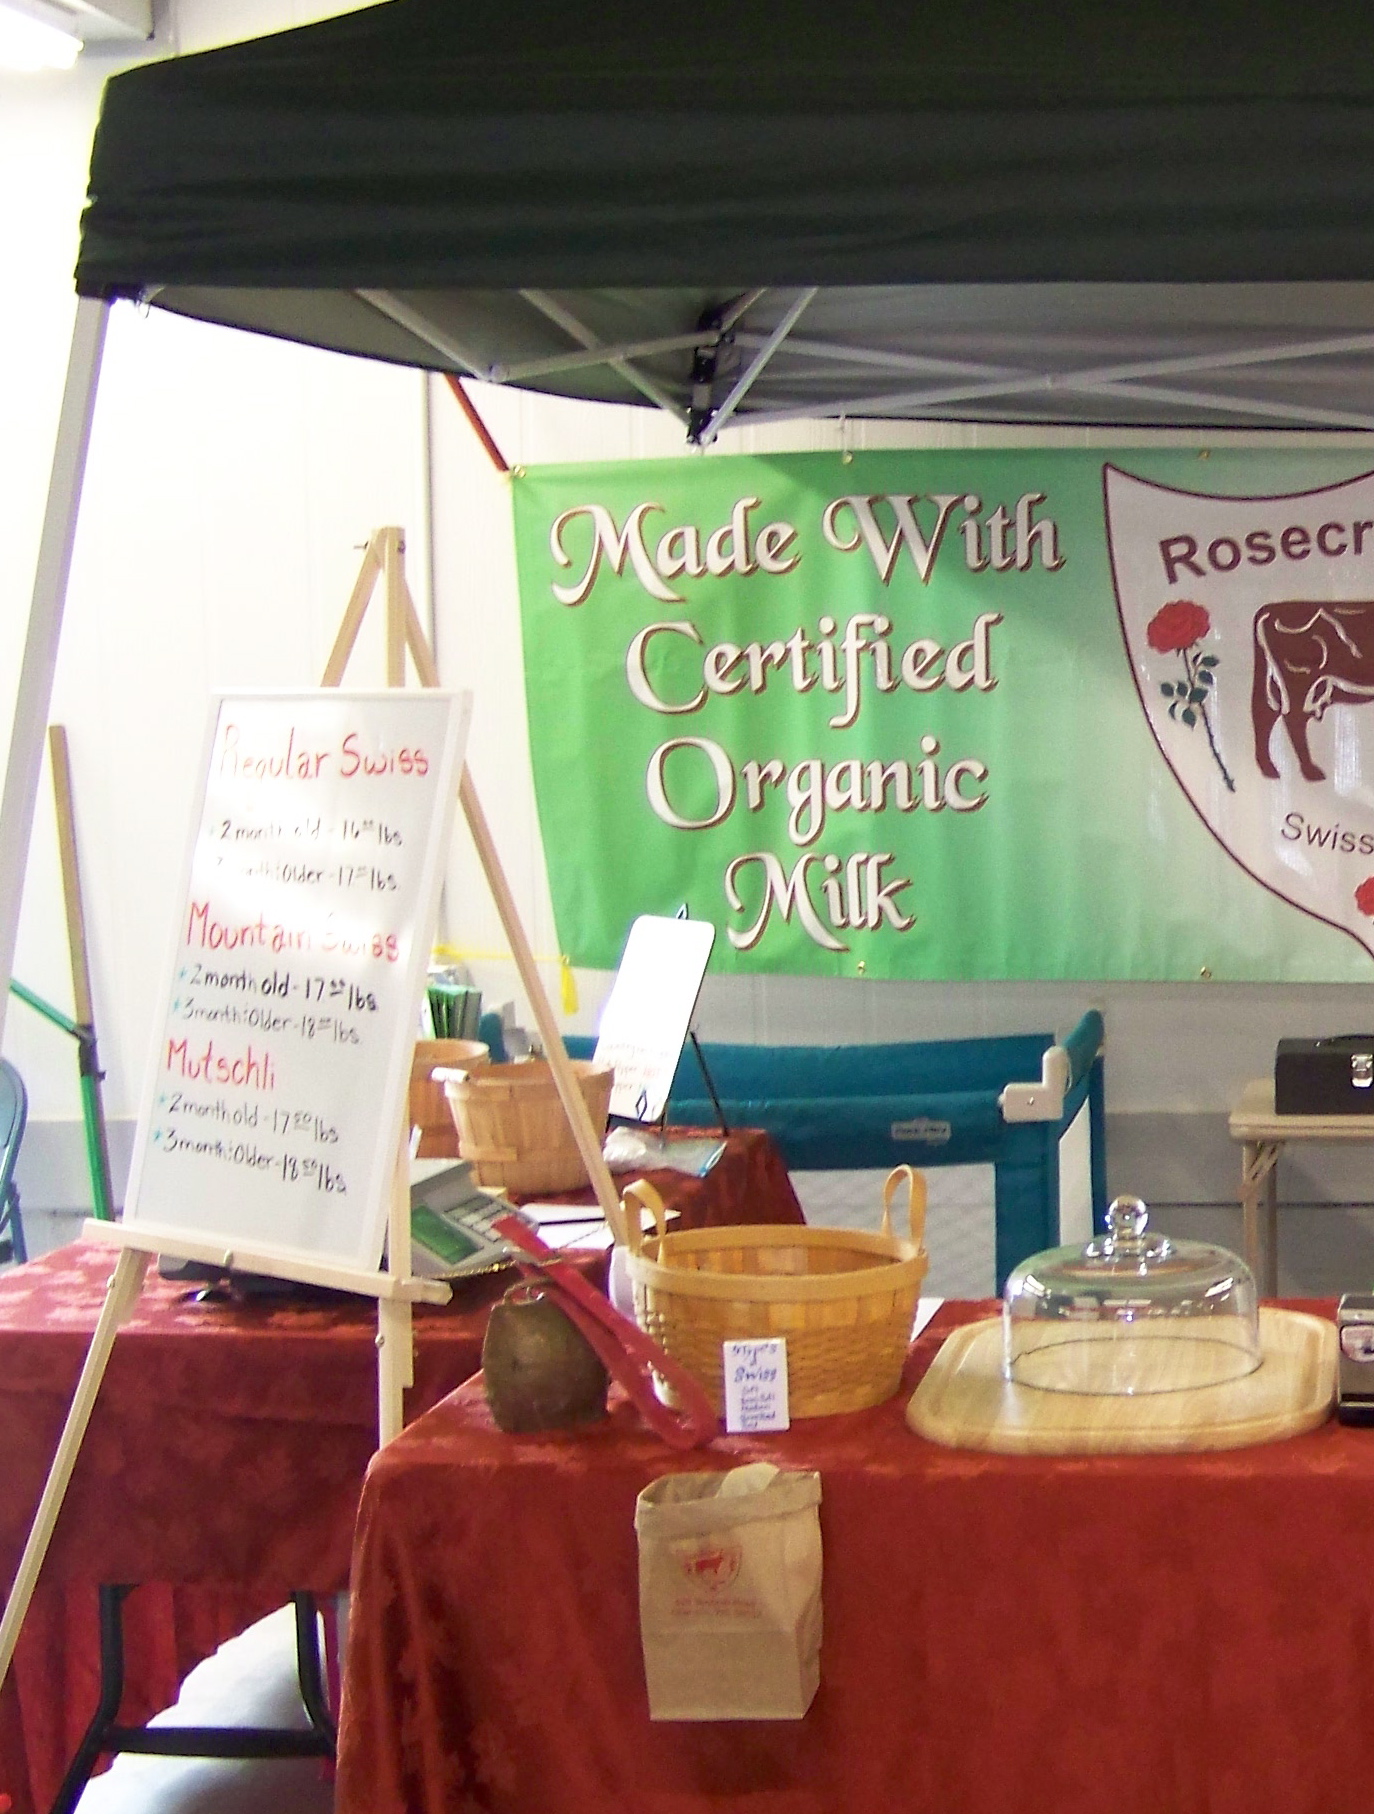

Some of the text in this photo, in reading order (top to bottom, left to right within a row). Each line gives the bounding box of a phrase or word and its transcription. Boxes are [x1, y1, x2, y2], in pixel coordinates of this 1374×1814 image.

[550, 492, 1067, 606] Made With
[625, 612, 1004, 728] Certified
[340, 733, 429, 777] Swiss
[645, 735, 989, 846] Organic
[1280, 811, 1374, 855] Swiss
[187, 901, 311, 953] Mountain
[724, 851, 916, 952] Milk
[167, 1038, 275, 1091] Mutschli
